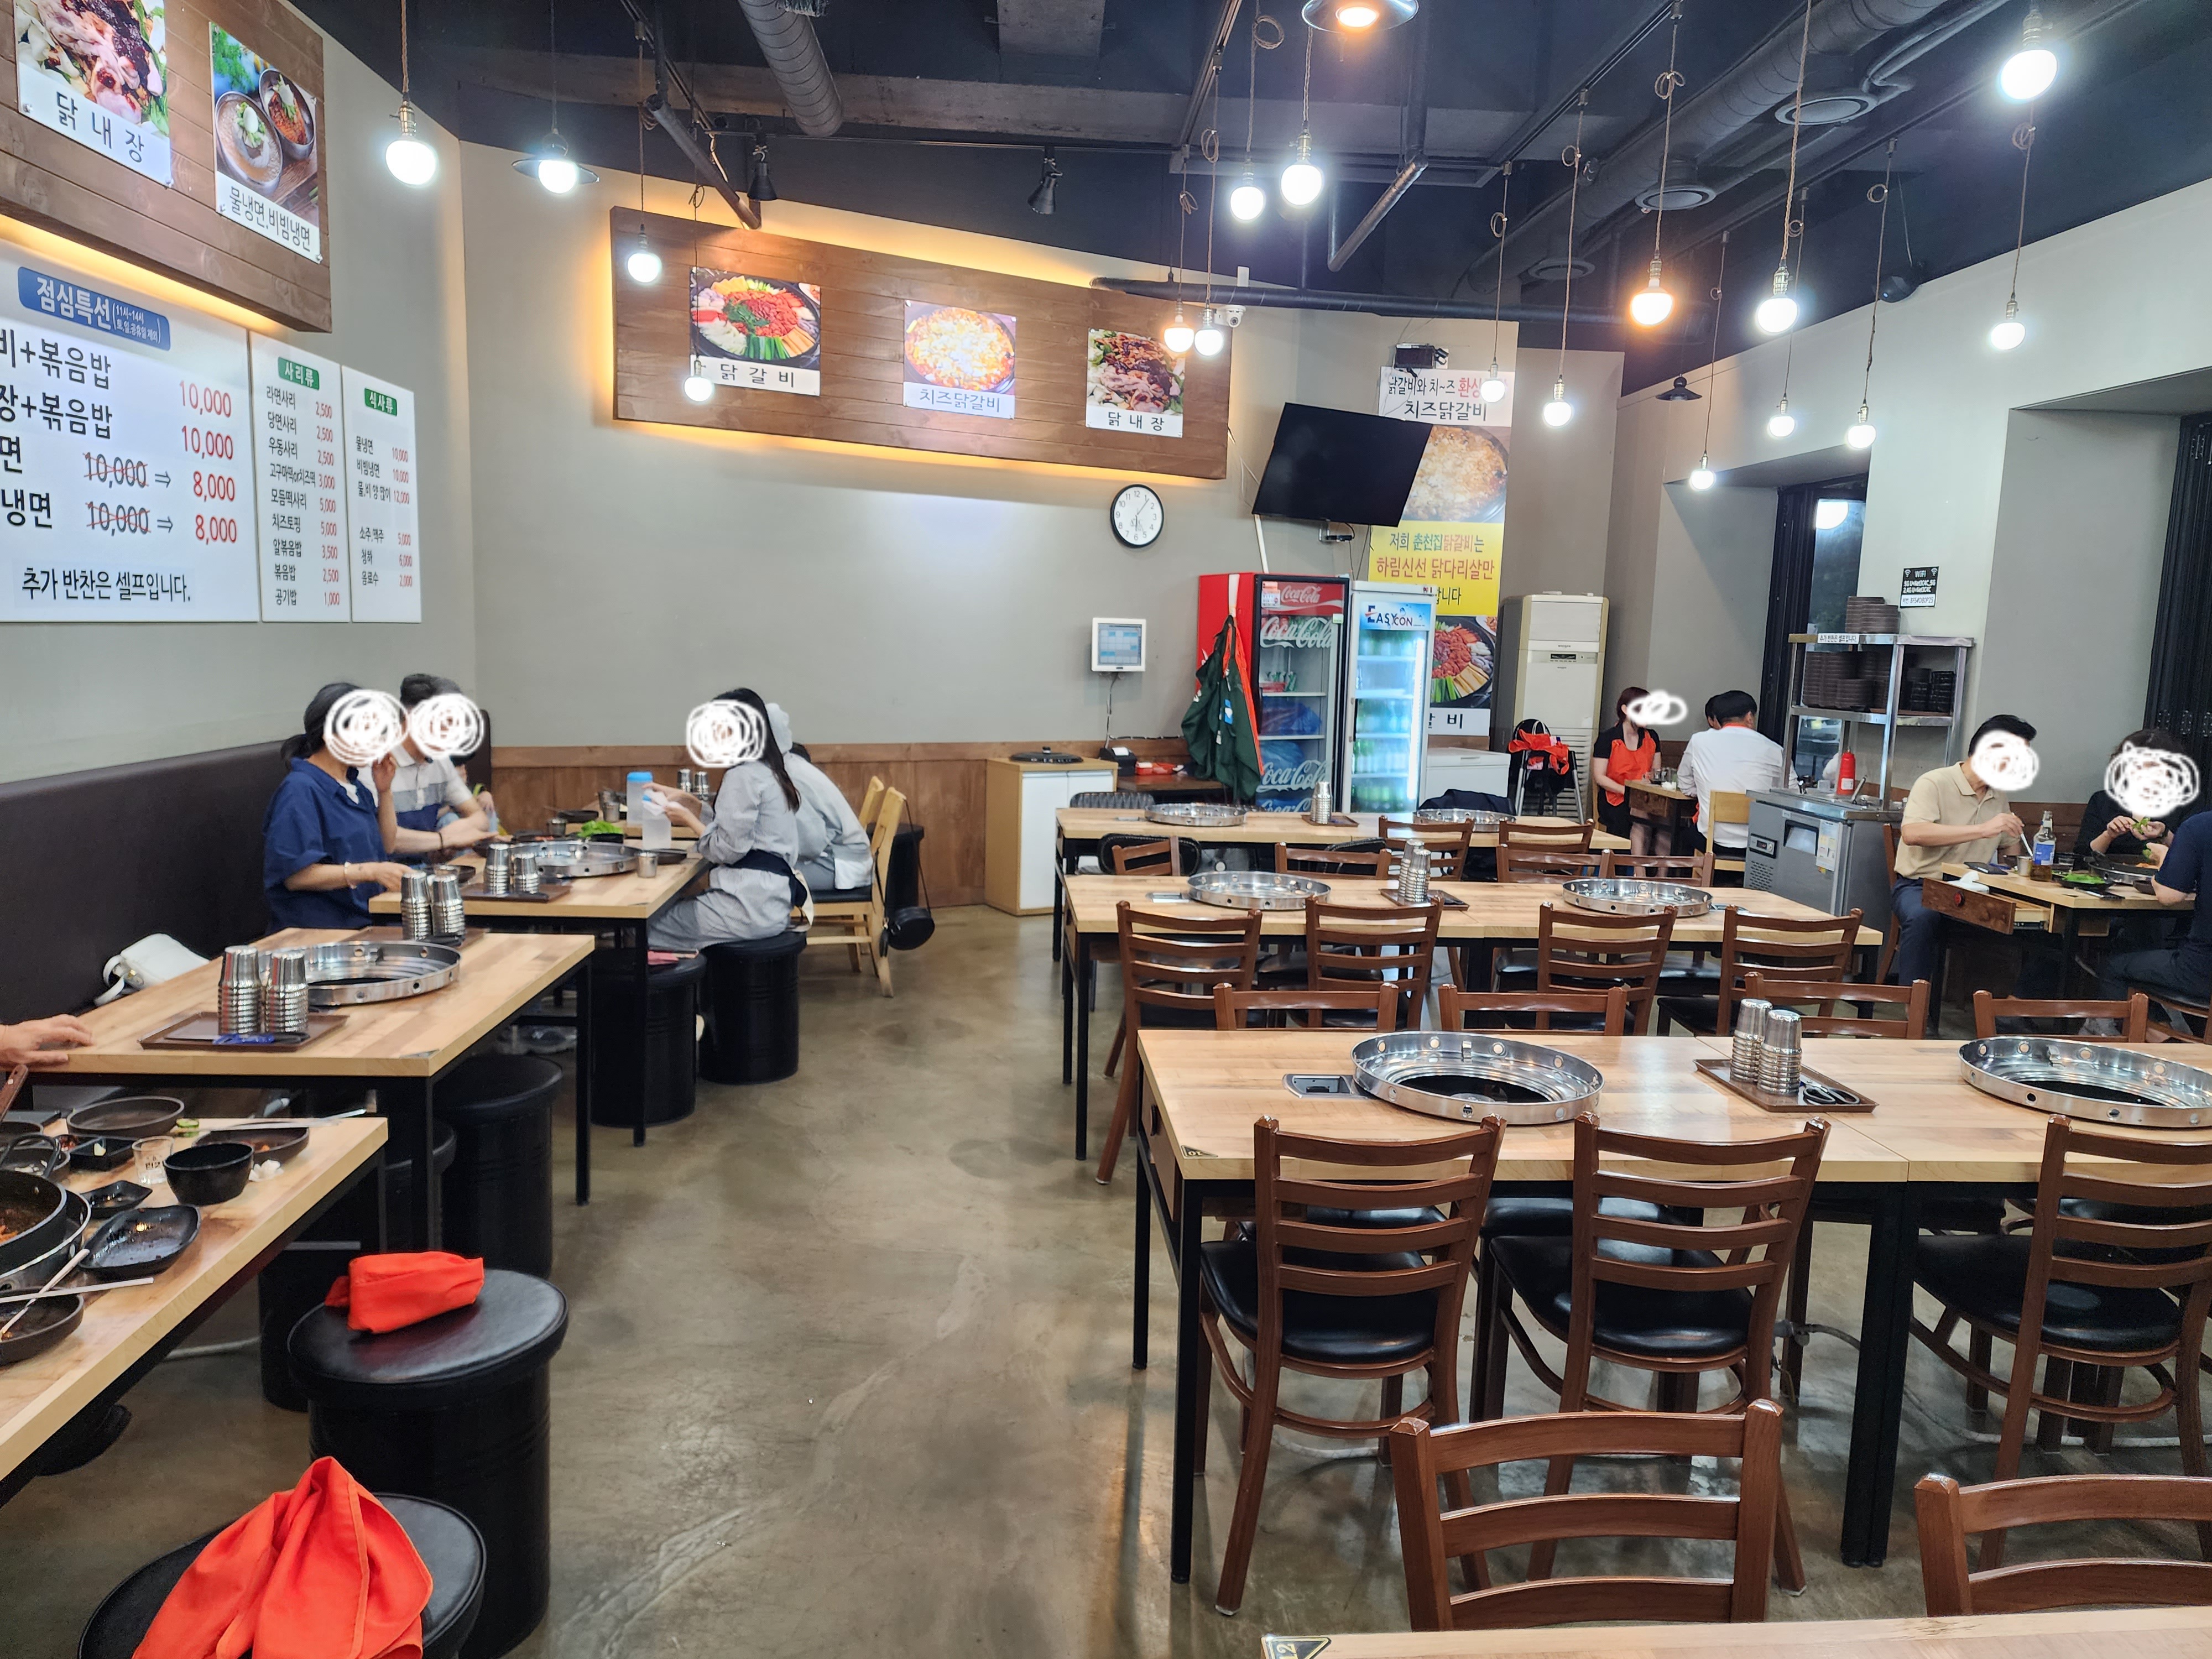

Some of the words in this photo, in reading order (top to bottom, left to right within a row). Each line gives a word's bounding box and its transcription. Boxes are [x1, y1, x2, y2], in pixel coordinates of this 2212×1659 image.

[284, 361, 314, 387] 사리류
[180, 380, 232, 418] 10,000
[267, 386, 296, 410] 라면사리
[316, 401, 332, 419] 2,500
[920, 389, 1000, 413] 치즈닭갈비
[1404, 400, 1487, 421] 치즈닭갈비
[268, 411, 296, 435] 당면사리
[317, 426, 333, 443] 2,500
[181, 425, 233, 460] 10,000
[269, 437, 298, 460] 우동사리
[317, 450, 334, 466] 2,500
[0, 436, 23, 474] 면
[392, 447, 409, 463] 10,000
[84, 452, 148, 488] 10,000
[193, 471, 236, 502] 8,000
[319, 474, 335, 490] 3,000
[393, 468, 409, 484] 10,000
[1, 489, 53, 530] 냉면
[320, 498, 336, 514] 5,000
[87, 502, 149, 536] 10,000
[196, 515, 237, 545] 8,000
[272, 513, 301, 533] 치즈토핑
[321, 521, 337, 536] 5,000
[273, 539, 302, 558] 알볶음밥
[322, 545, 338, 560] 3,500
[1390, 533, 1410, 551] 저희
[1413, 533, 1484, 553] 춘천집닭갈비는
[274, 564, 296, 581] 볶음밥
[323, 568, 339, 585] 2,500
[362, 571, 379, 587] 음료수
[1376, 556, 1427, 578] 하림신선
[1431, 558, 1495, 581] 닭다리살만
[22, 567, 58, 601] 추가
[62, 570, 111, 600] 반찬은
[116, 572, 191, 602] 셀프입니다.
[275, 589, 297, 606] 공기밥
[324, 592, 340, 607] 1,000
